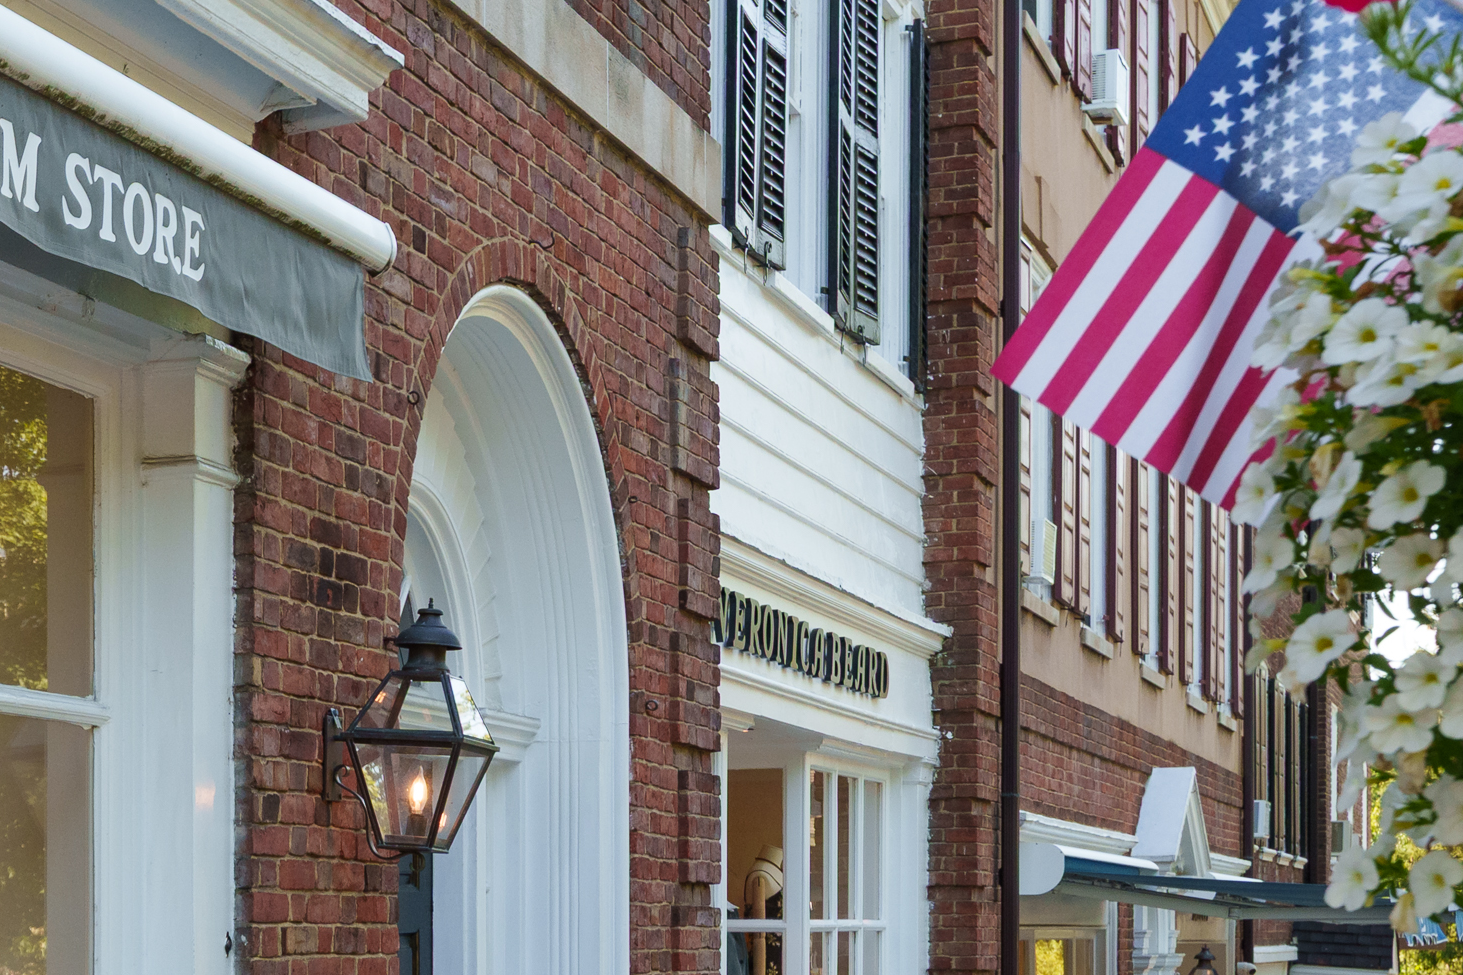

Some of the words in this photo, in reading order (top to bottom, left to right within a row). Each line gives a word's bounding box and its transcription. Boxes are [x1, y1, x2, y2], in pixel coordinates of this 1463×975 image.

[61, 152, 206, 282] STORE
[713, 586, 825, 679] VERONICA
[826, 631, 890, 699] BEARD
